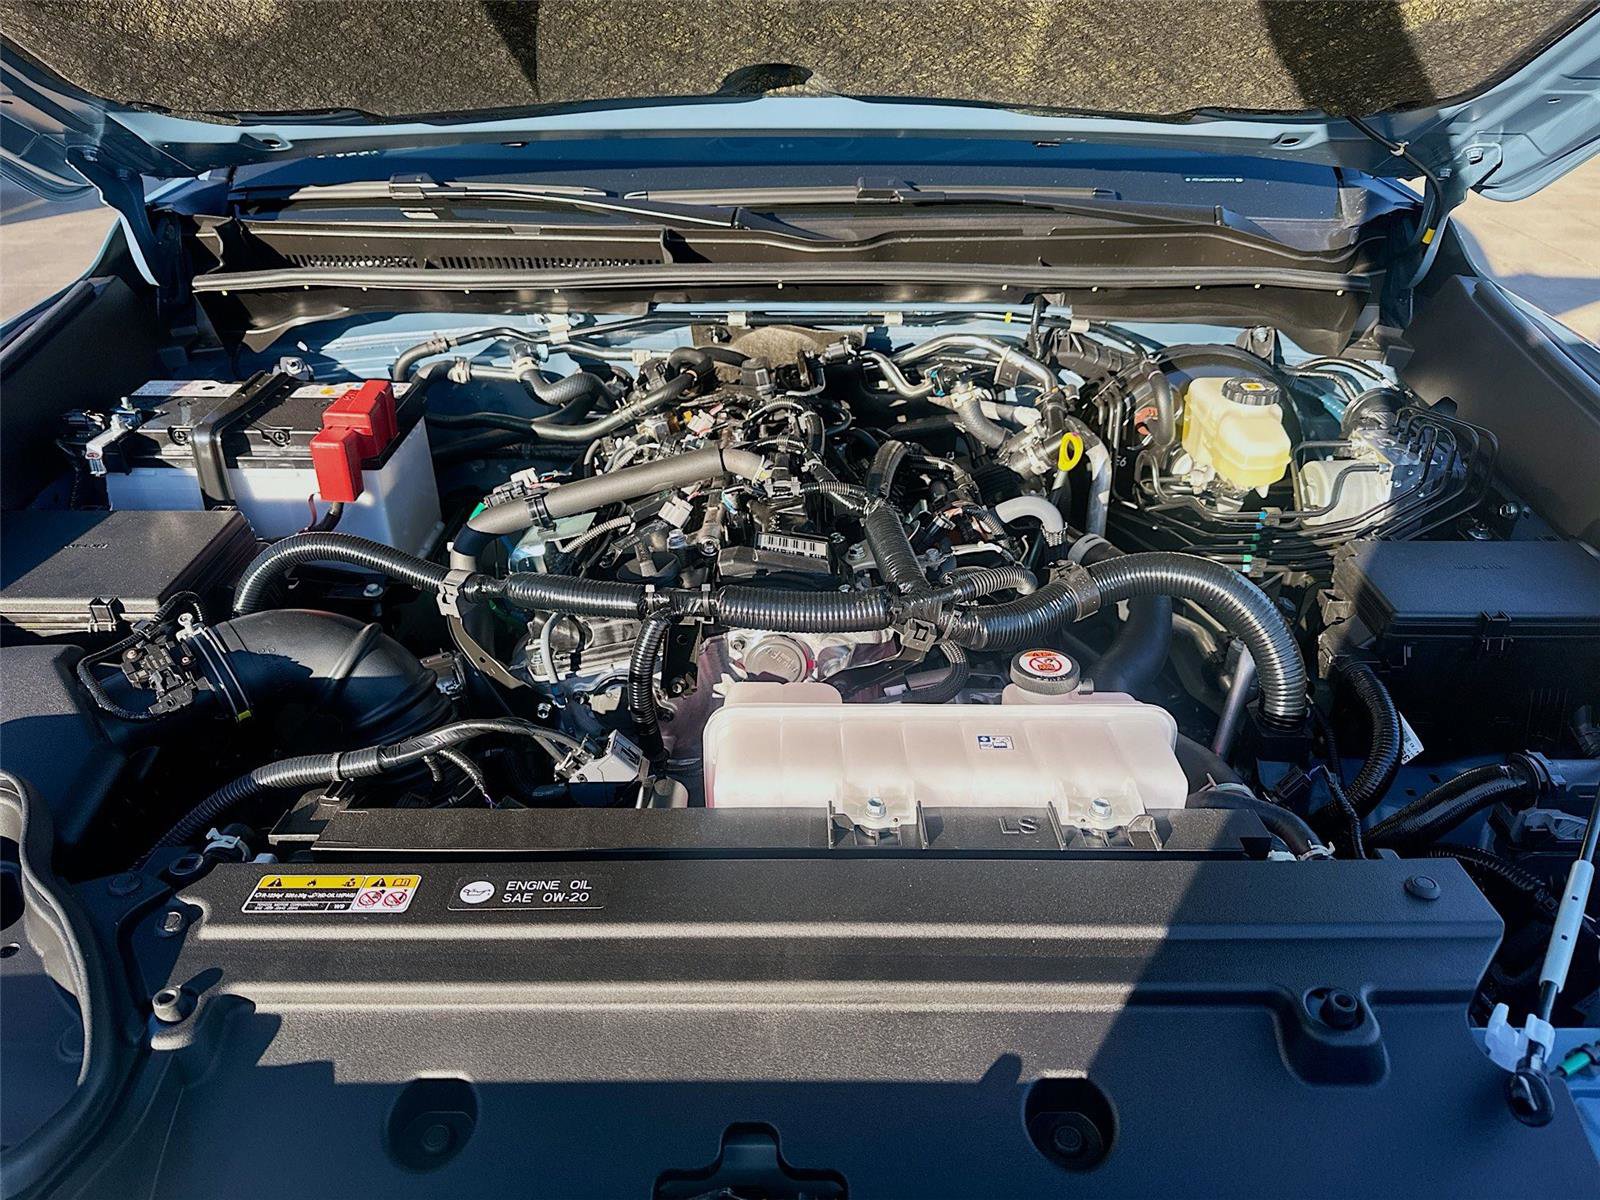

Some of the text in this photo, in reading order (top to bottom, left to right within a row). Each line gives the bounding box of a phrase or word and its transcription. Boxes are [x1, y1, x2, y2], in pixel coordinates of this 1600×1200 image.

[998, 816, 1039, 834] LS
[506, 880, 593, 891] ENGINE OIL
[501, 892, 590, 903] SAE 0W-20
